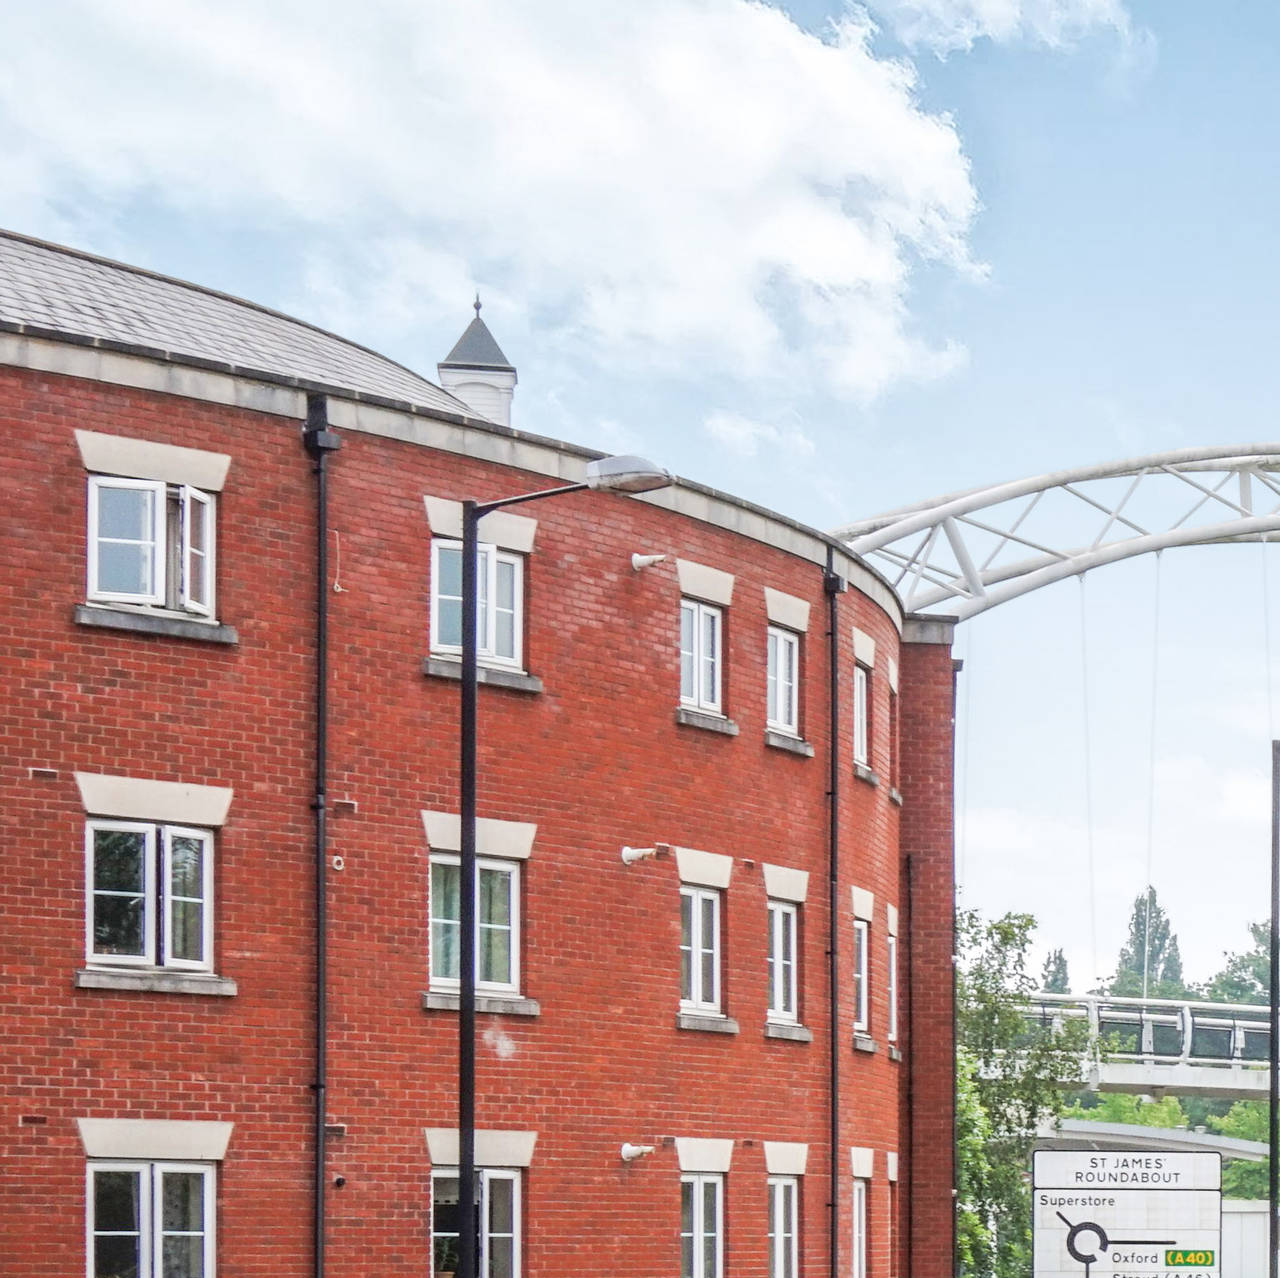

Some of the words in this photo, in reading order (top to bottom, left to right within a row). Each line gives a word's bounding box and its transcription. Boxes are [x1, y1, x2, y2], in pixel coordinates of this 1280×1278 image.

[1090, 1158, 1107, 1169] ST
[1075, 1172, 1181, 1183] ROUNDABOUT
[1040, 1195, 1116, 1208] Superstore
[1112, 1252, 1158, 1264] Oxford
[1166, 1251, 1213, 1265] (A40)
